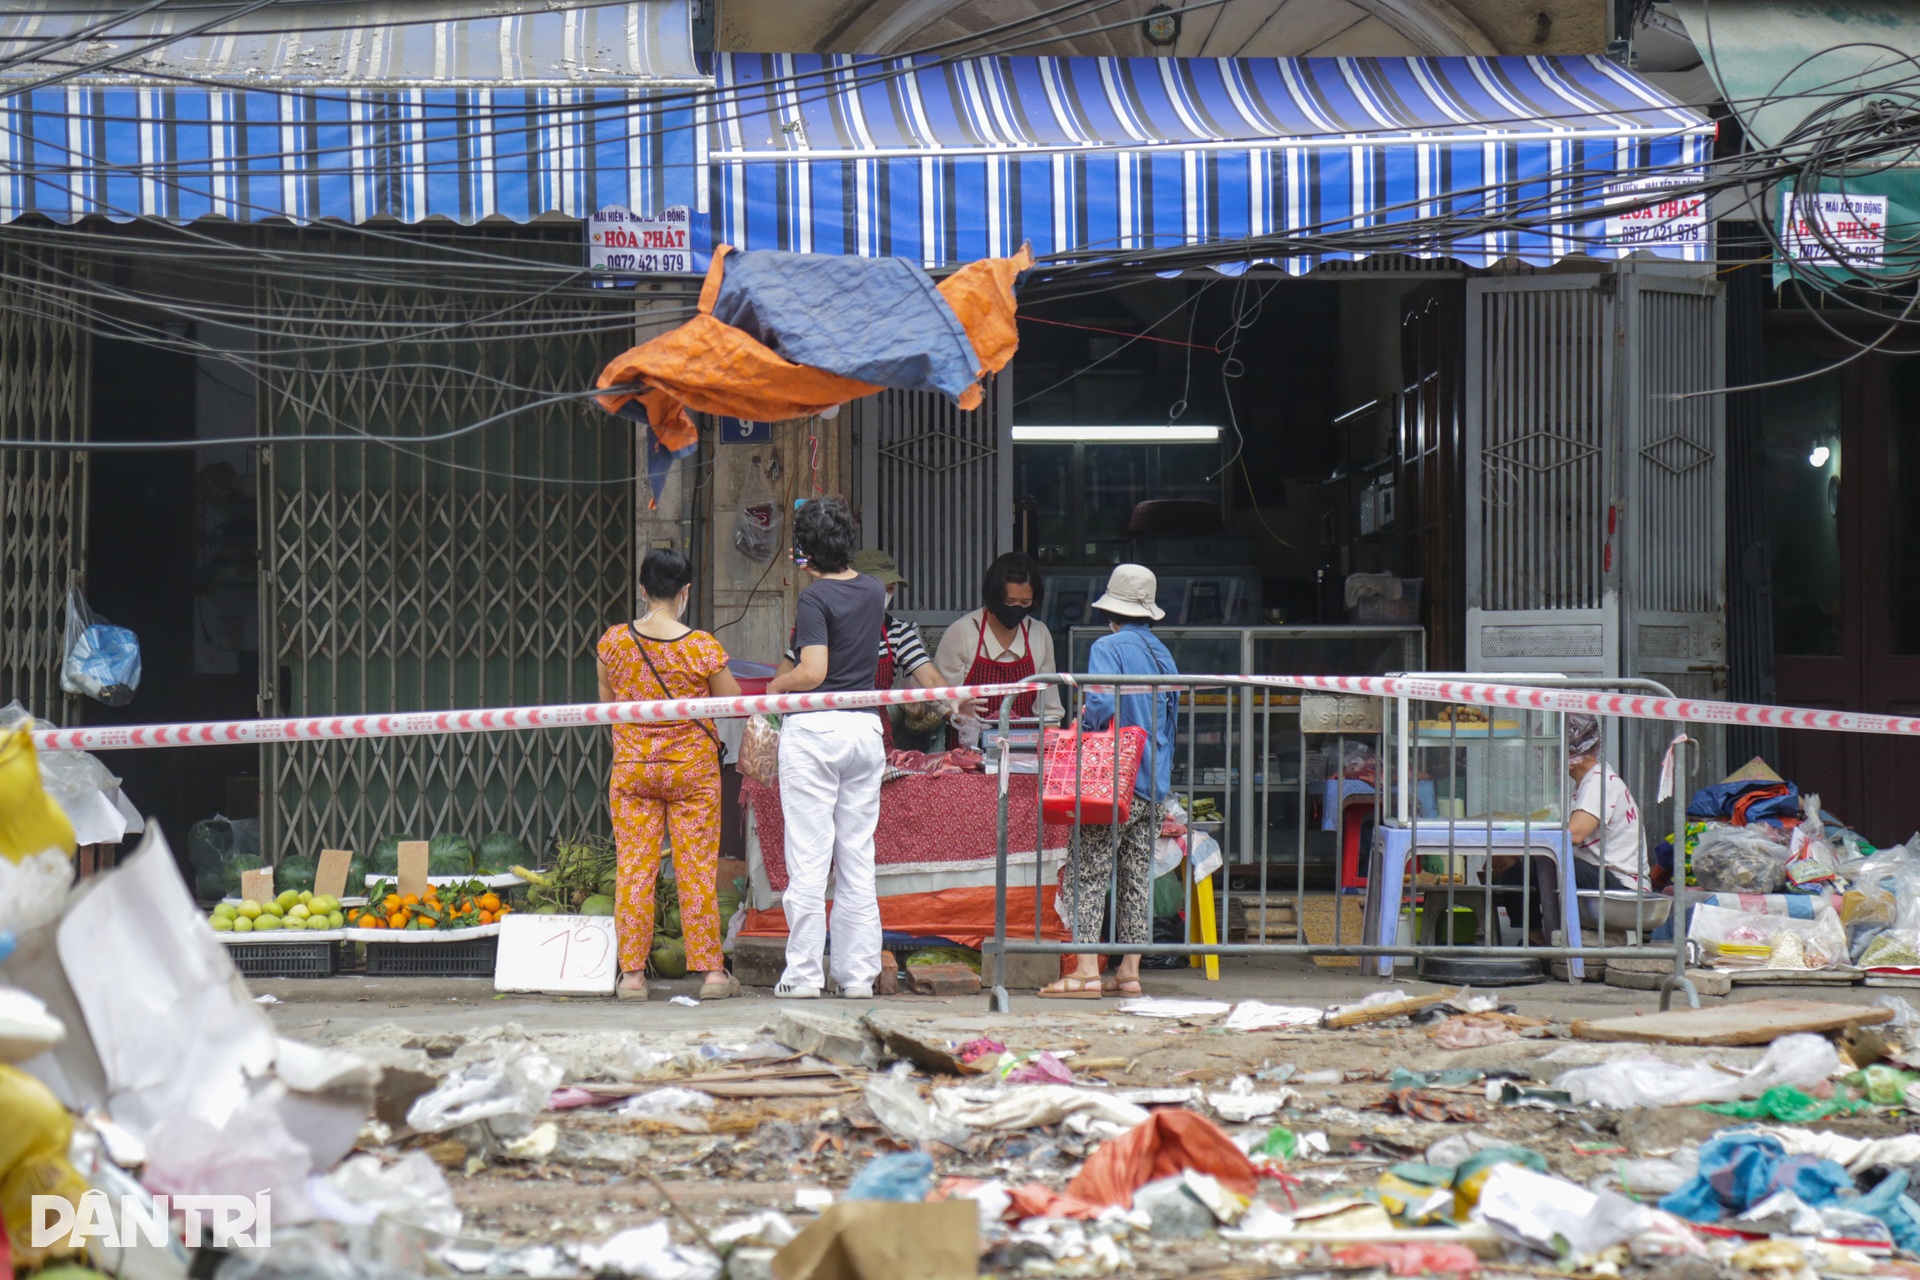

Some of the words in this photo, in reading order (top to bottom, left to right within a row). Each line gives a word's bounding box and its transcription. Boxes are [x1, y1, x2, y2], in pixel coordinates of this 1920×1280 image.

[608, 209, 624, 222] HIÊN
[667, 208, 685, 224] ĐỘNG
[1826, 199, 1839, 212] MÁI
[1855, 202, 1863, 213] DI
[1864, 201, 1882, 216] ĐỘNG
[604, 226, 639, 248] HÒA
[643, 225, 685, 248] PHÁT
[1677, 223, 1699, 241] 979
[1836, 217, 1880, 240] PHÁT
[607, 254, 636, 271] 0972
[639, 254, 658, 271] 421
[662, 254, 684, 271] 979
[1320, 713, 1366, 726] STOP
